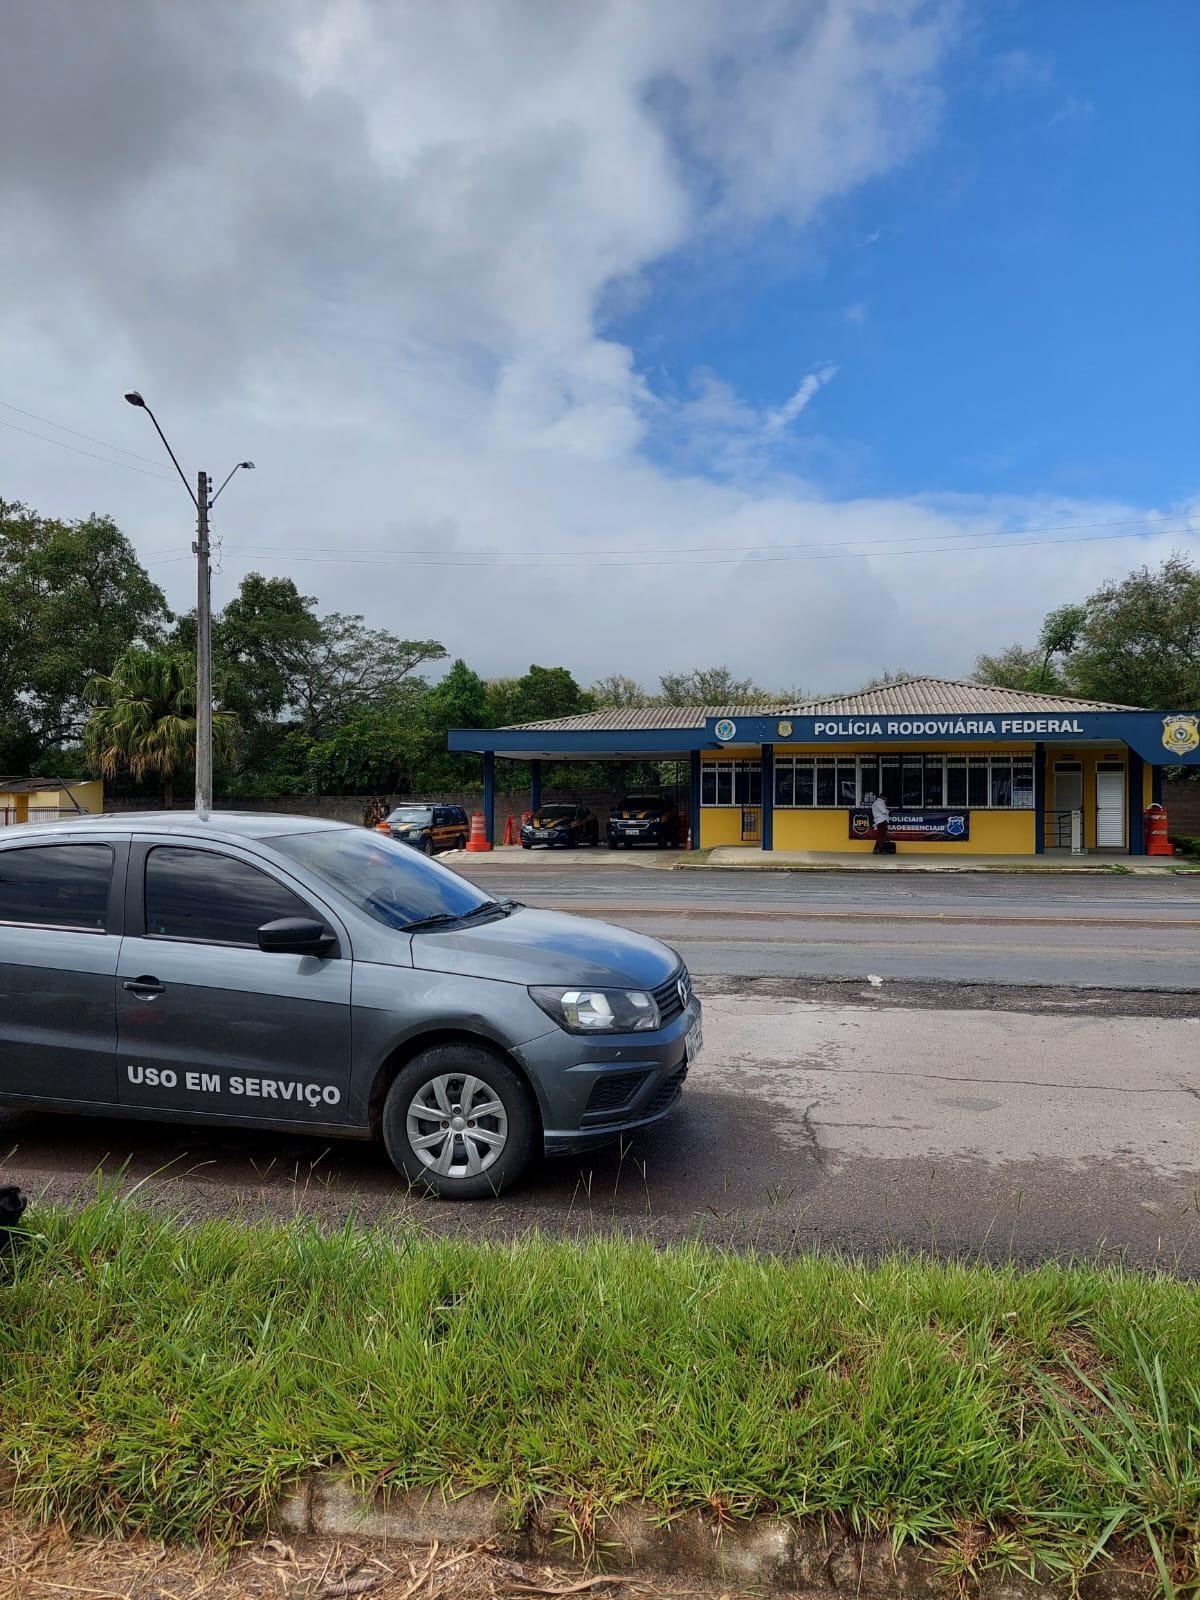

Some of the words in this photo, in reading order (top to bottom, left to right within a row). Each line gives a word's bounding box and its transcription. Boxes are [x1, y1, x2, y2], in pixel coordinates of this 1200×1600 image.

[814, 719, 882, 736] POLÍCIA
[887, 717, 996, 736] RODOVIÁRIA
[1001, 719, 1084, 734] FEDERAL
[127, 1065, 177, 1088] USO
[185, 1071, 221, 1093] EM
[229, 1076, 341, 1107] SERVIÇO
